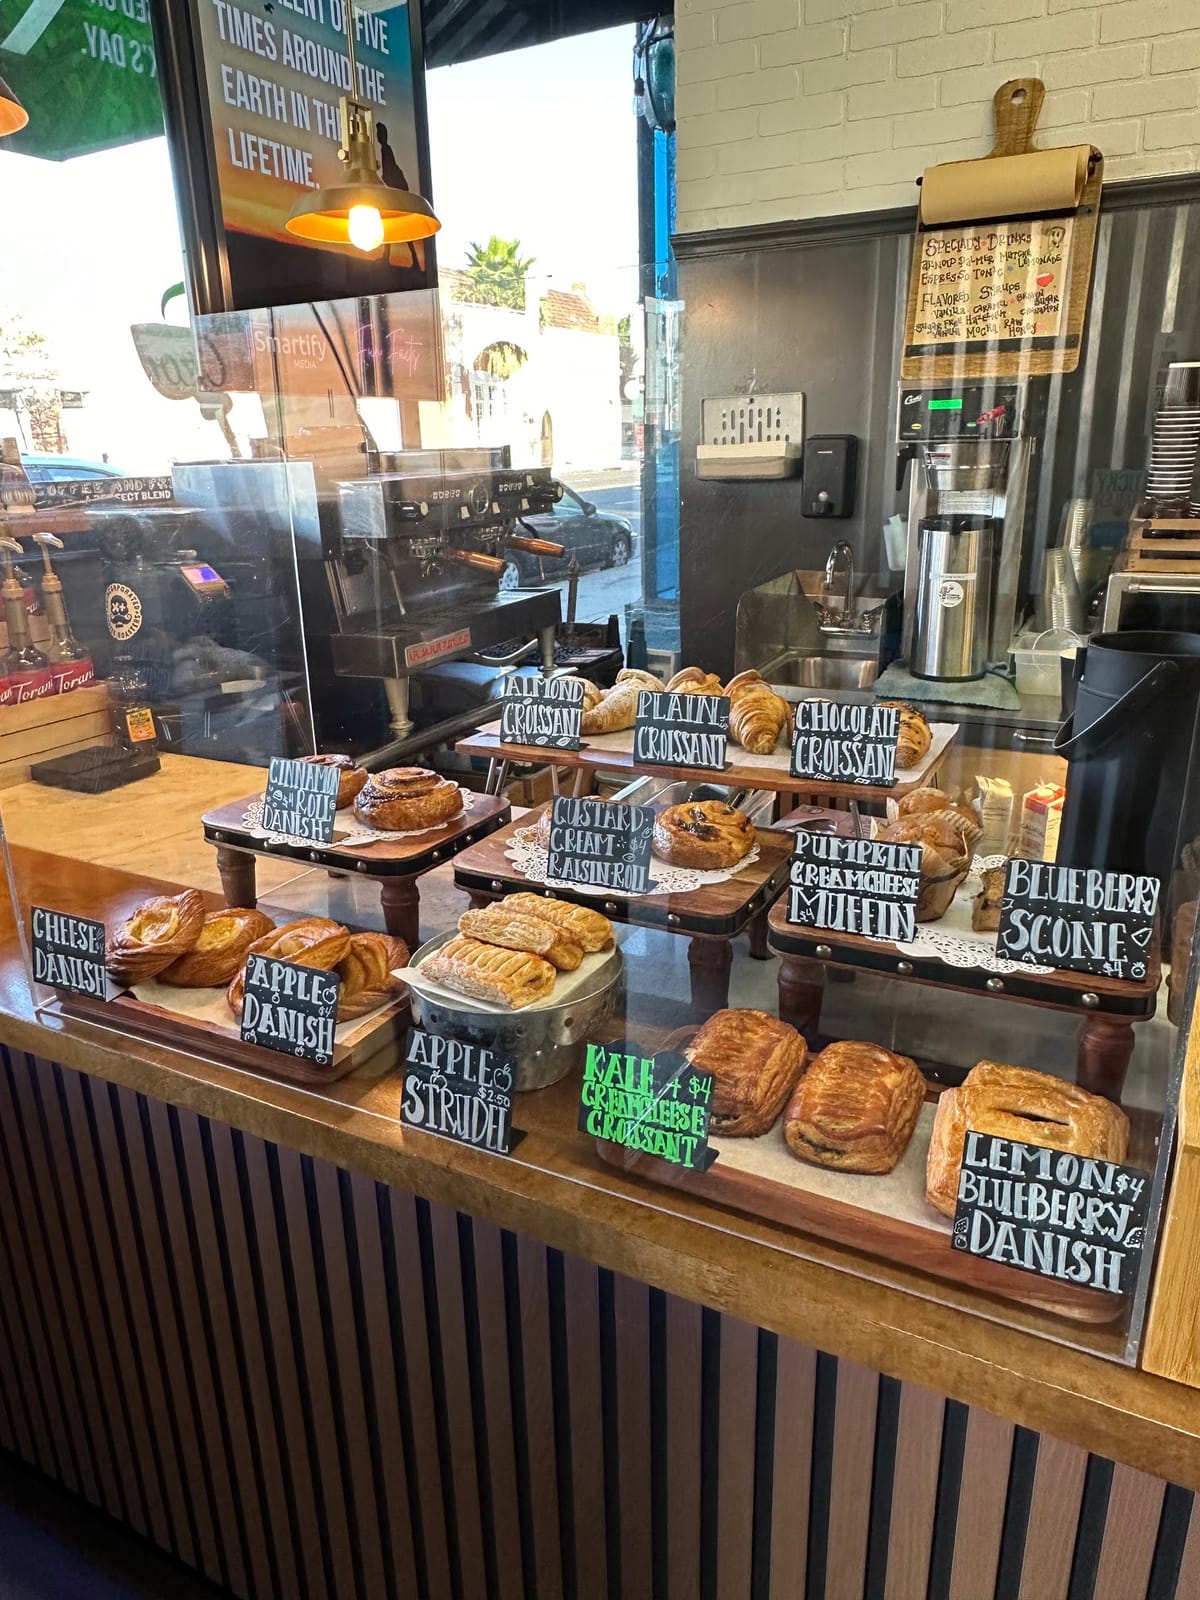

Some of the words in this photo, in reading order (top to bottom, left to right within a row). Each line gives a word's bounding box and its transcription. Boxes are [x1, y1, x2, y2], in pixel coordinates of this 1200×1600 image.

[212, 0, 278, 61] TIMES
[282, 29, 353, 92] AROUND
[356, 61, 387, 106] THE
[353, 5, 389, 55] FIVE
[221, 63, 287, 124] EARTH
[290, 90, 311, 131] IN
[312, 98, 342, 142] TH
[228, 127, 320, 190] LIFETIME.
[254, 330, 327, 362] Smartify
[293, 359, 317, 369] MEDIA
[141, 490, 171, 501] BLEND
[11, 673, 54, 705] Torani
[53, 662, 95, 695] Torani
[502, 675, 584, 702] ALMOND
[637, 691, 720, 725] PLAIN
[502, 702, 583, 737] CROISSANT
[795, 702, 900, 738] CHOCOLATE
[637, 727, 727, 769] CROISSANT
[795, 735, 897, 781] CROISSANT
[263, 803, 326, 841] DANISH
[295, 788, 332, 822] ROLL
[553, 796, 644, 832] CUSTARD
[550, 827, 616, 856] CREAM
[629, 837, 647, 856] $4
[794, 831, 923, 873] PUMPKIN
[1007, 859, 1161, 916] BLUEBERRY
[33, 908, 98, 954] CHEESE
[788, 884, 917, 943] MUFFIN
[1001, 909, 1128, 962] SCONE
[34, 946, 105, 998] DANISH
[249, 957, 326, 1006] APPLE
[242, 992, 335, 1056] DANISH
[406, 1030, 494, 1087] APPLE
[583, 1043, 655, 1100] KALE
[688, 1074, 712, 1104] $4
[401, 1074, 509, 1154] STRUDEL
[586, 1109, 698, 1168] CROISSANT
[965, 1132, 1120, 1196] LEMON
[1115, 1172, 1146, 1203] $4
[957, 1168, 1135, 1243] BLUEBERRY
[969, 1208, 1126, 1295] DANISH
